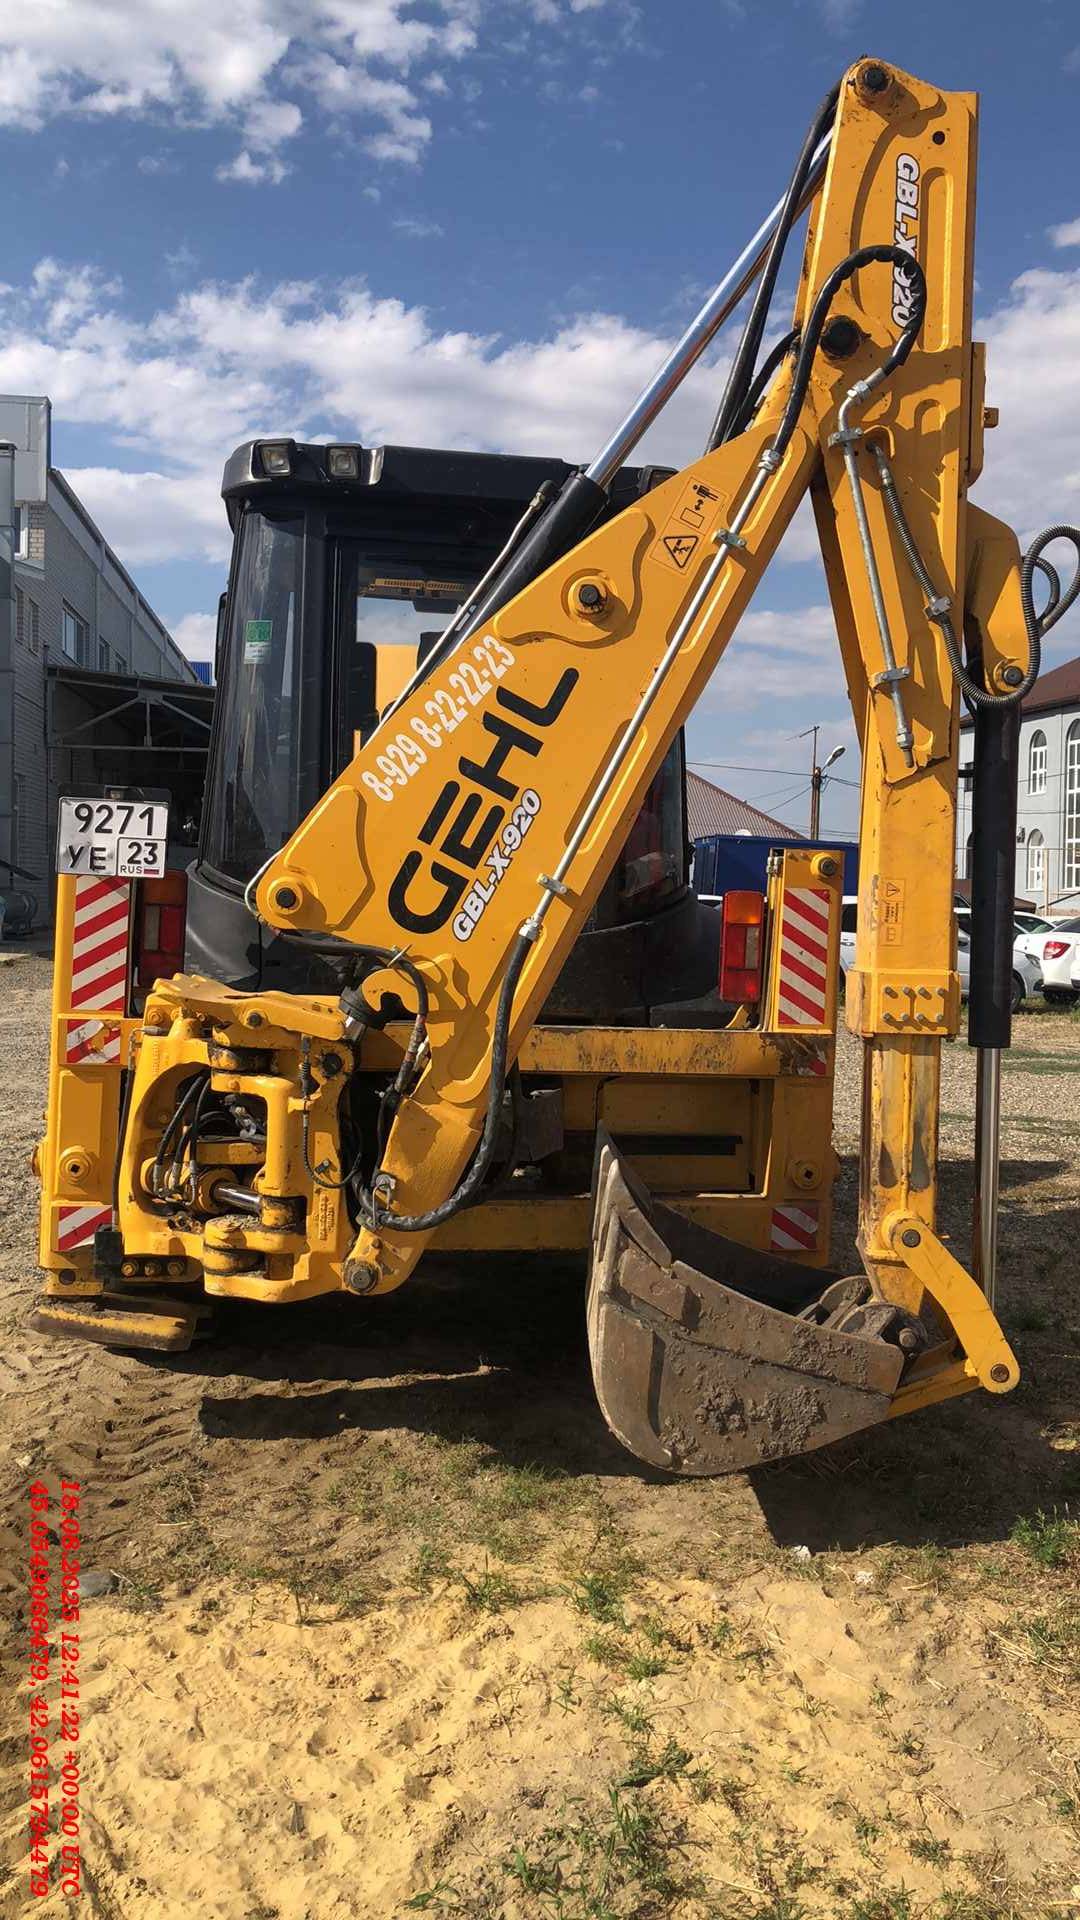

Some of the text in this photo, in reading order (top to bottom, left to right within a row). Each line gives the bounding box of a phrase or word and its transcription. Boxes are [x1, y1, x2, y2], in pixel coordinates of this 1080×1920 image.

[362, 635, 515, 801] 8-929 8-22-22-23
[74, 803, 154, 836] 9271
[388, 667, 580, 935] GEHL
[119, 865, 143, 874] RUS
[127, 841, 158, 865] 23
[452, 788, 542, 942] GBL-X-920
